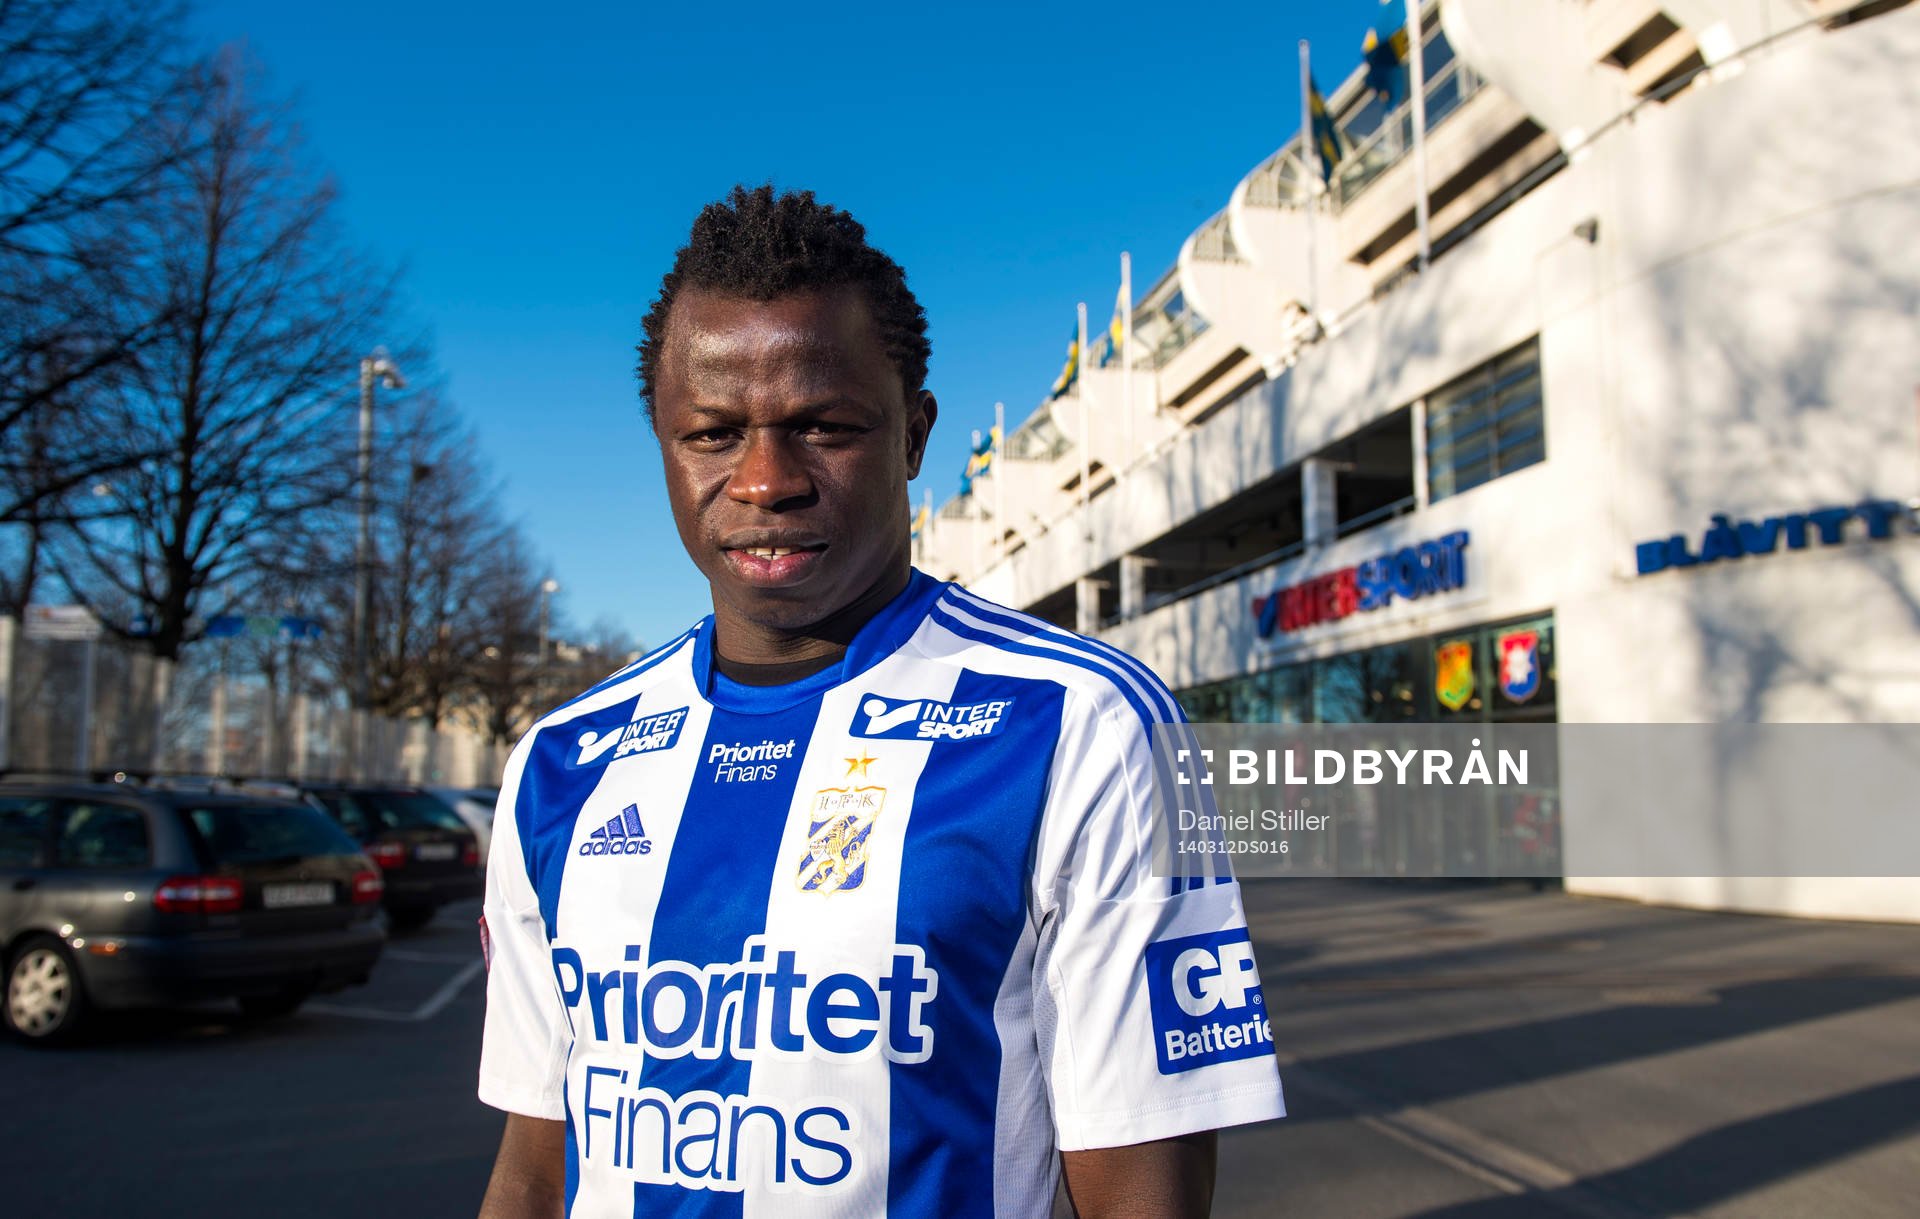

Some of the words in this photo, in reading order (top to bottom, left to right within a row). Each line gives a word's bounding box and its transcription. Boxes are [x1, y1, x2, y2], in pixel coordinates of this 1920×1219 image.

[921, 701, 1006, 723] INTER
[621, 711, 680, 742] INTER
[916, 717, 1001, 740] SPORT
[613, 730, 675, 759] SPORT
[708, 739, 796, 764] Prioritet
[714, 762, 778, 784] Finans
[579, 837, 652, 857] adidas
[1172, 940, 1262, 1017] GP
[552, 943, 930, 1054] Prioritet
[584, 1065, 854, 1186] Finans
